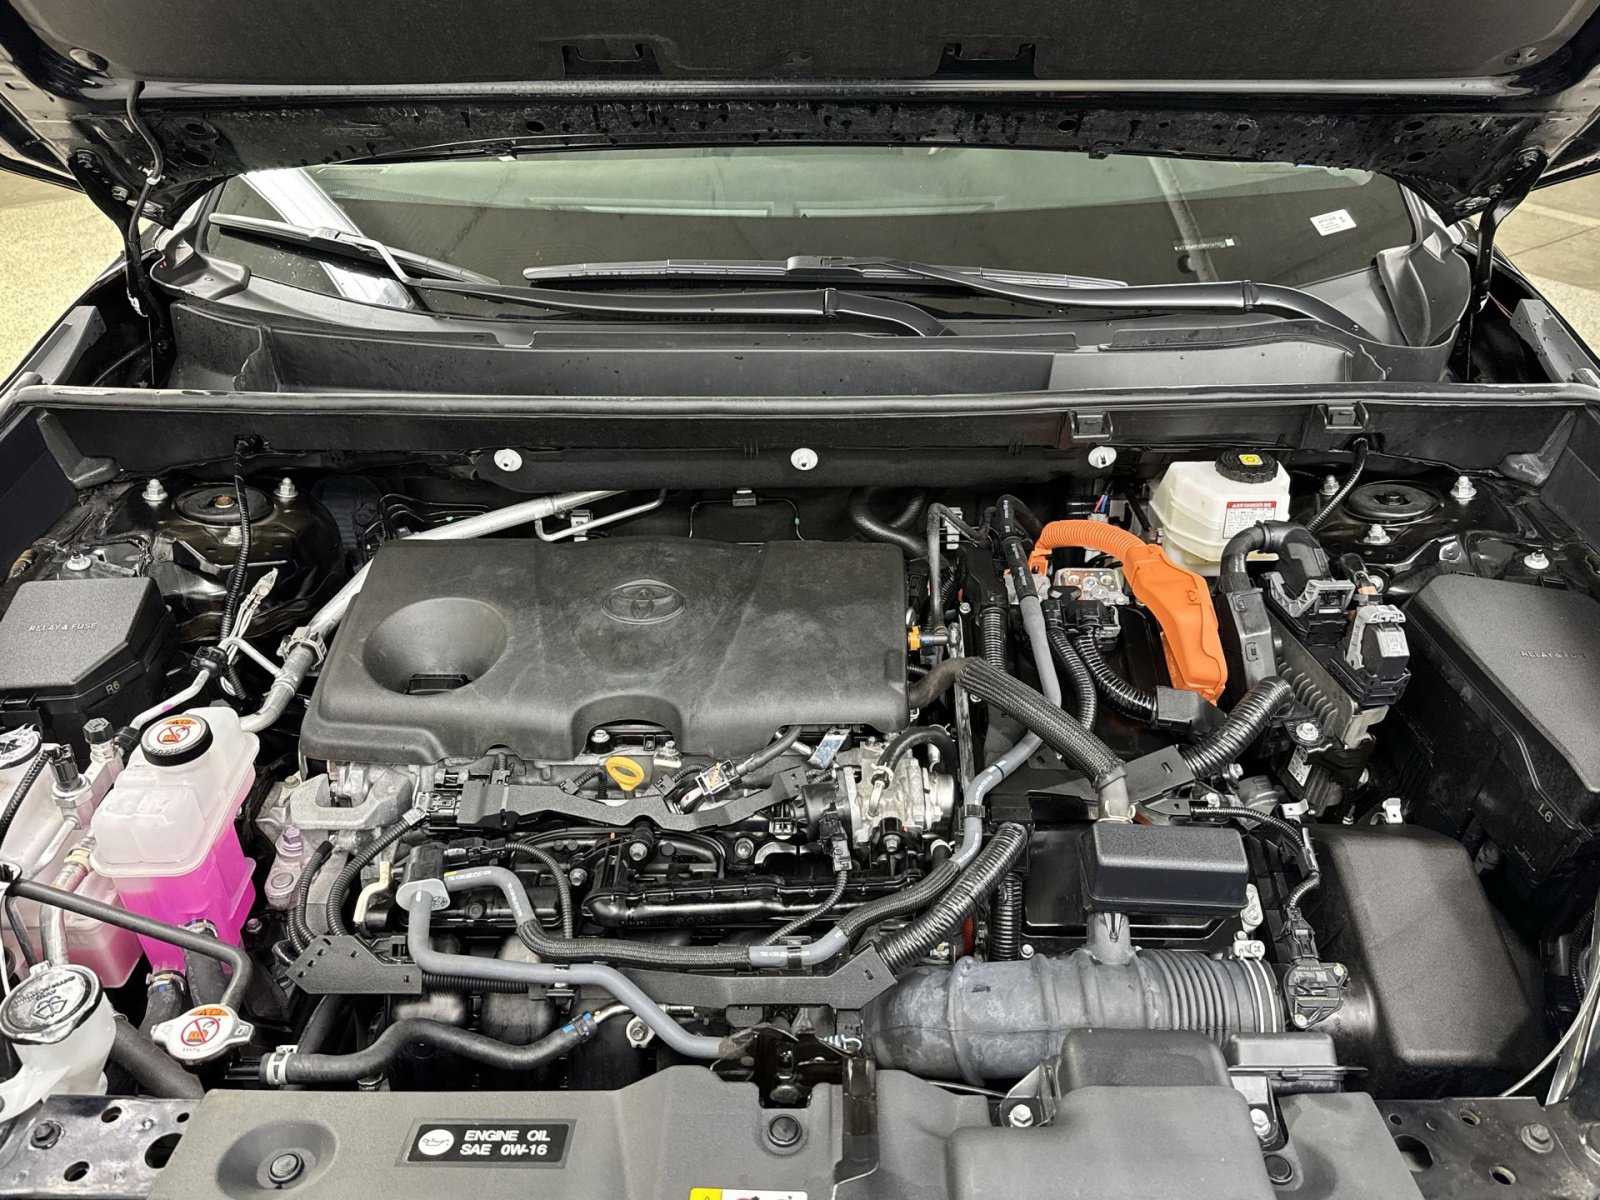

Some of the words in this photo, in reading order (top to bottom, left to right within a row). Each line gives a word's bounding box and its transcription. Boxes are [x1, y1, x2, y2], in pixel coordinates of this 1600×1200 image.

[70, 622, 97, 630] FUSE
[105, 680, 120, 695] R6
[1538, 803, 1553, 823] L6
[464, 1130, 519, 1141] ENGINE
[526, 1130, 551, 1141] OIL
[460, 1144, 492, 1155] SAE
[501, 1144, 547, 1155] 0W-16
